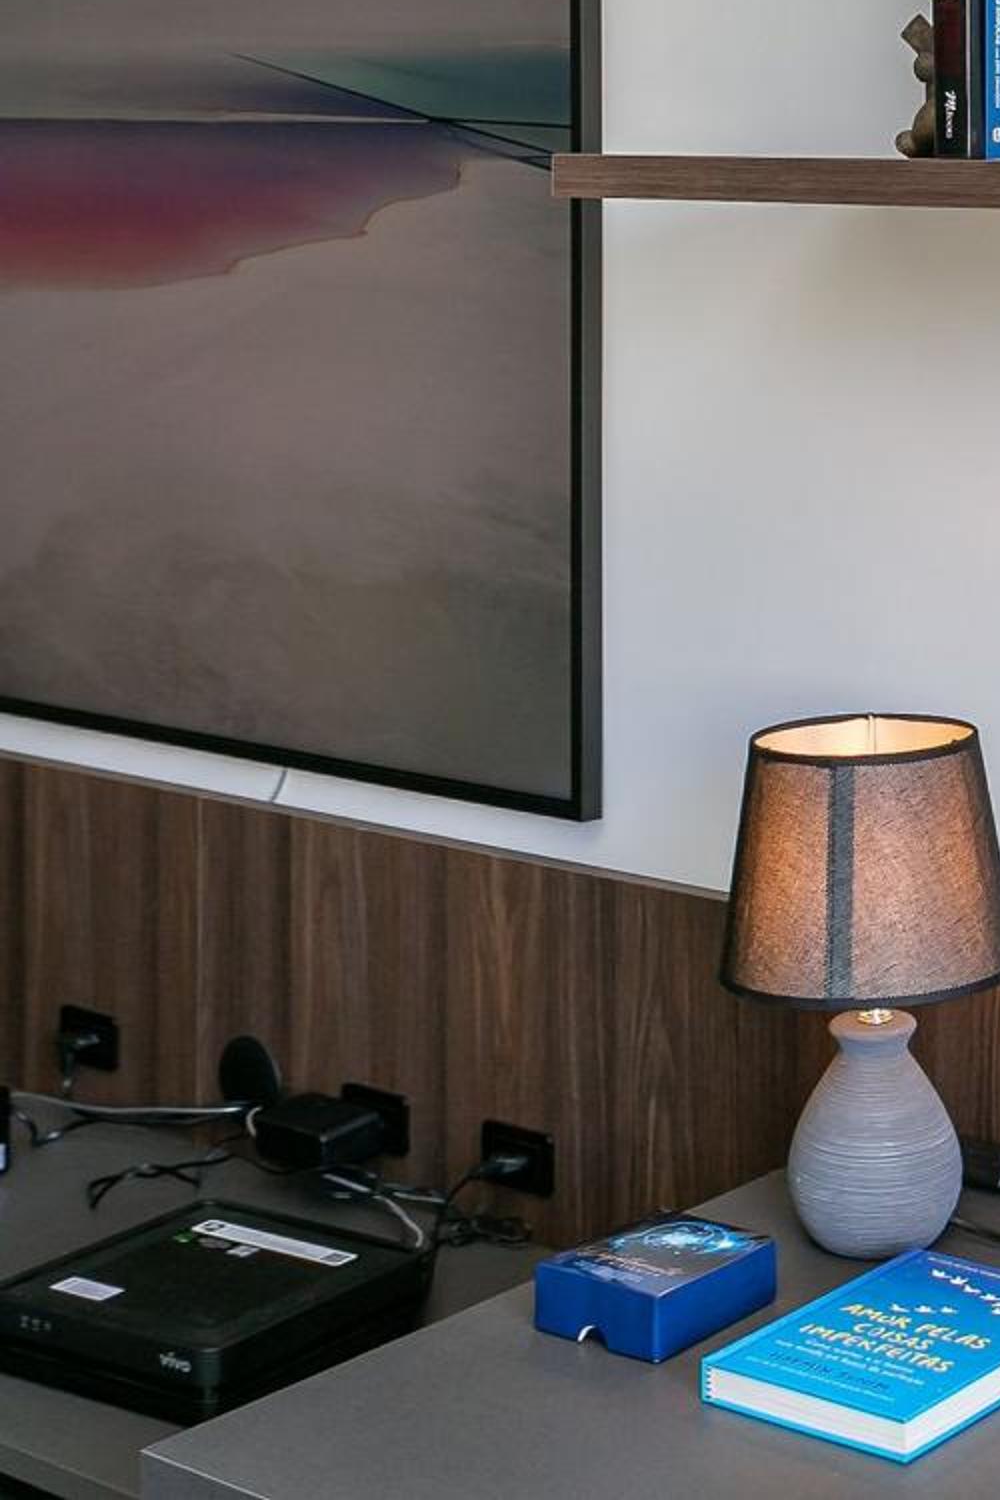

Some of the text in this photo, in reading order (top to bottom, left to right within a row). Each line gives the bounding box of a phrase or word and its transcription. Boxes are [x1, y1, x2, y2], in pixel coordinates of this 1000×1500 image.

[799, 1323, 955, 1373] IMPERFEITAS
[839, 1303, 992, 1350] AMOR PELAS
[853, 1322, 935, 1350] COISAS
